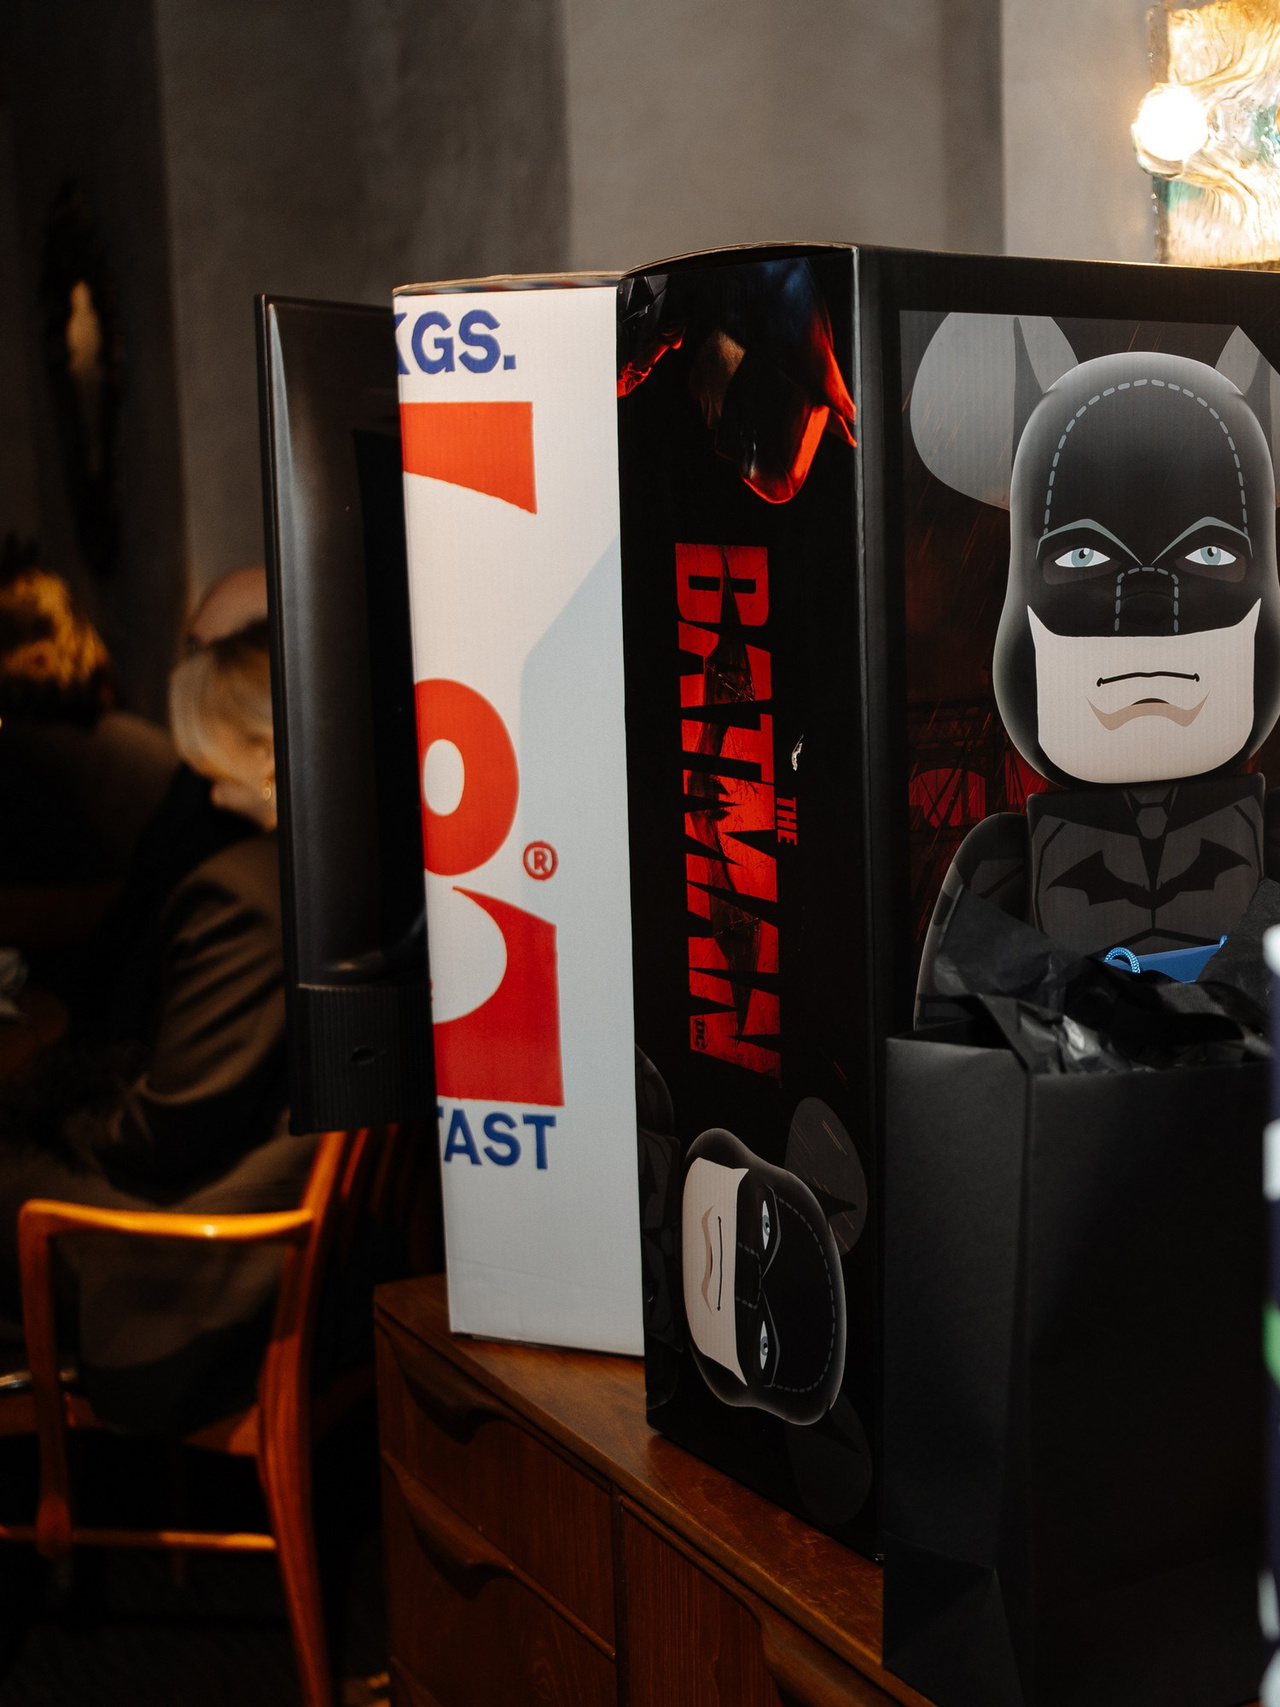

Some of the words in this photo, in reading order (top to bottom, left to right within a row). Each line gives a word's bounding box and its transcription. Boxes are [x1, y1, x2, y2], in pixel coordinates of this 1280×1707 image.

[675, 543, 781, 1081] BATMAN
[776, 797, 798, 846] THE
[437, 1104, 557, 1171] AST
